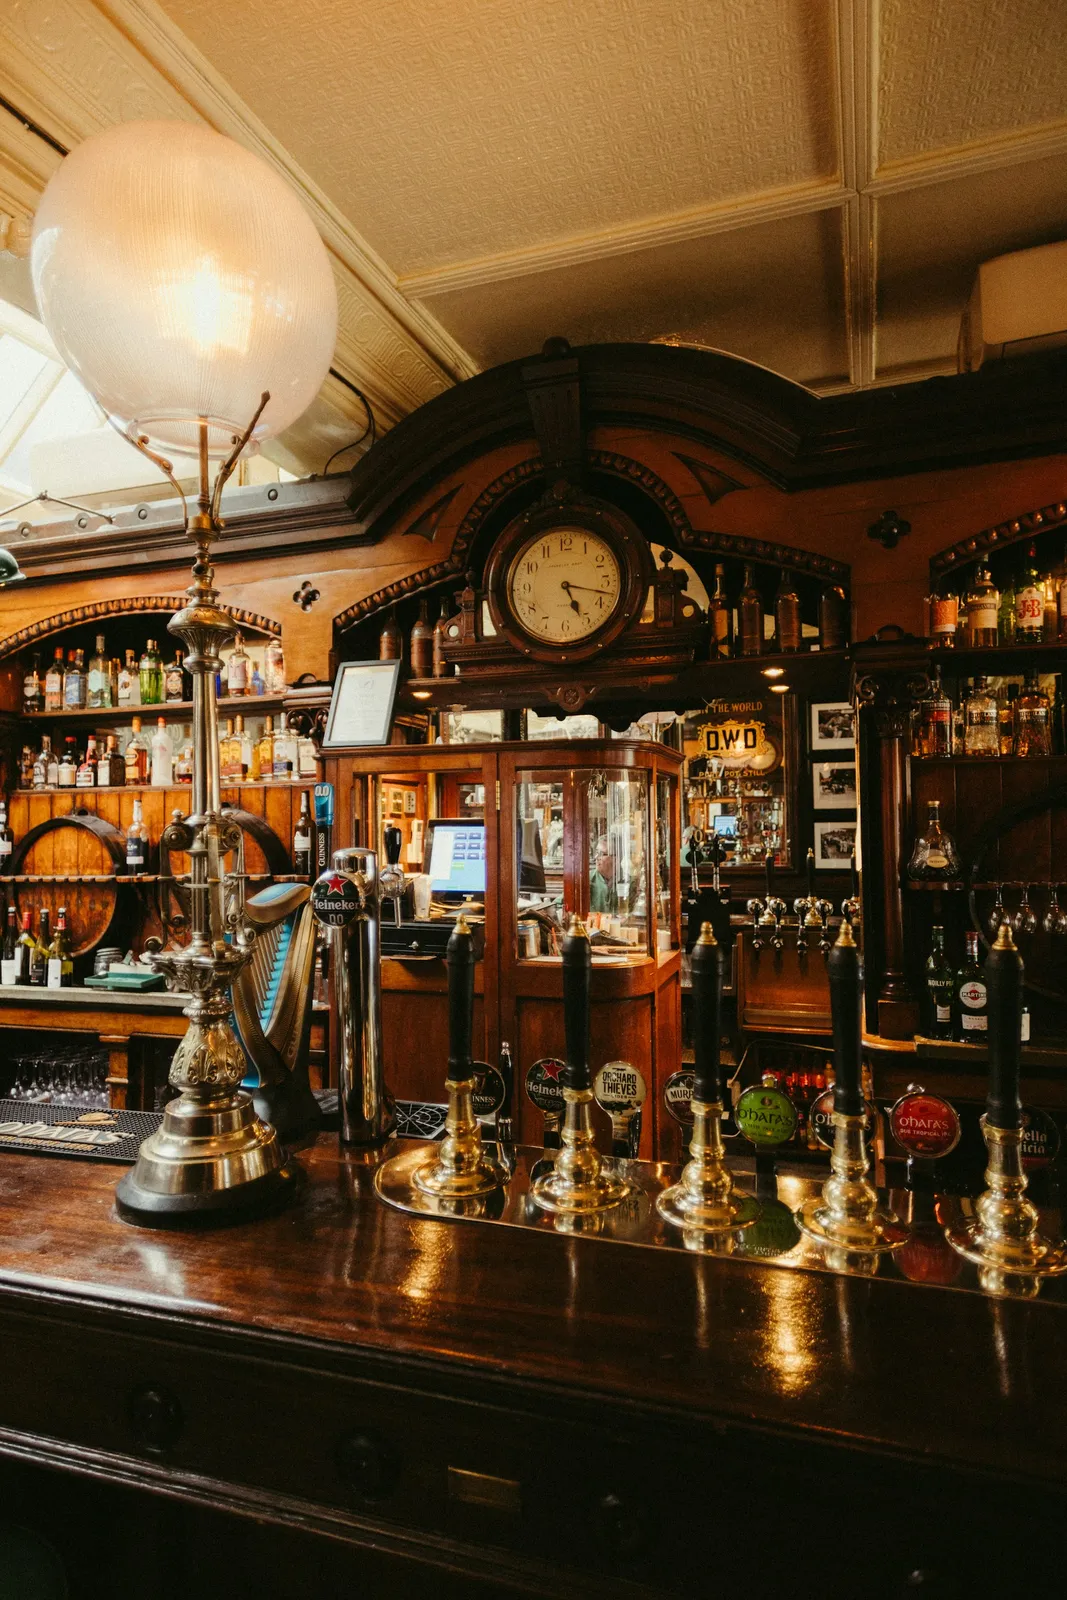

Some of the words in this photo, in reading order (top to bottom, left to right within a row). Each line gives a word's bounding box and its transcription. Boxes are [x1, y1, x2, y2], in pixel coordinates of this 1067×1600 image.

[560, 538, 573, 551] 12
[583, 541, 587, 555] 1
[542, 545, 550, 559] 11
[595, 554, 605, 568] 2
[526, 561, 539, 575] 10
[601, 574, 610, 588] 3
[523, 583, 531, 595] 9
[528, 602, 537, 615] 8
[595, 596, 605, 609] 4
[1018, 599, 1041, 619] J&B
[541, 616, 549, 630] 7
[561, 619, 570, 632] 6
[582, 612, 591, 626] 5
[731, 701, 763, 712] WORLD
[724, 769, 739, 778] POT
[743, 769, 765, 777] STILL
[318, 832, 326, 867] GUINNESS
[927, 979, 945, 988] NOILLY
[602, 1071, 637, 1084] ORCHARD
[526, 1081, 563, 1098] Heinek
[602, 1082, 637, 1096] THIEVES
[670, 1089, 694, 1100] MURP
[472, 1094, 496, 1103] INNESS
